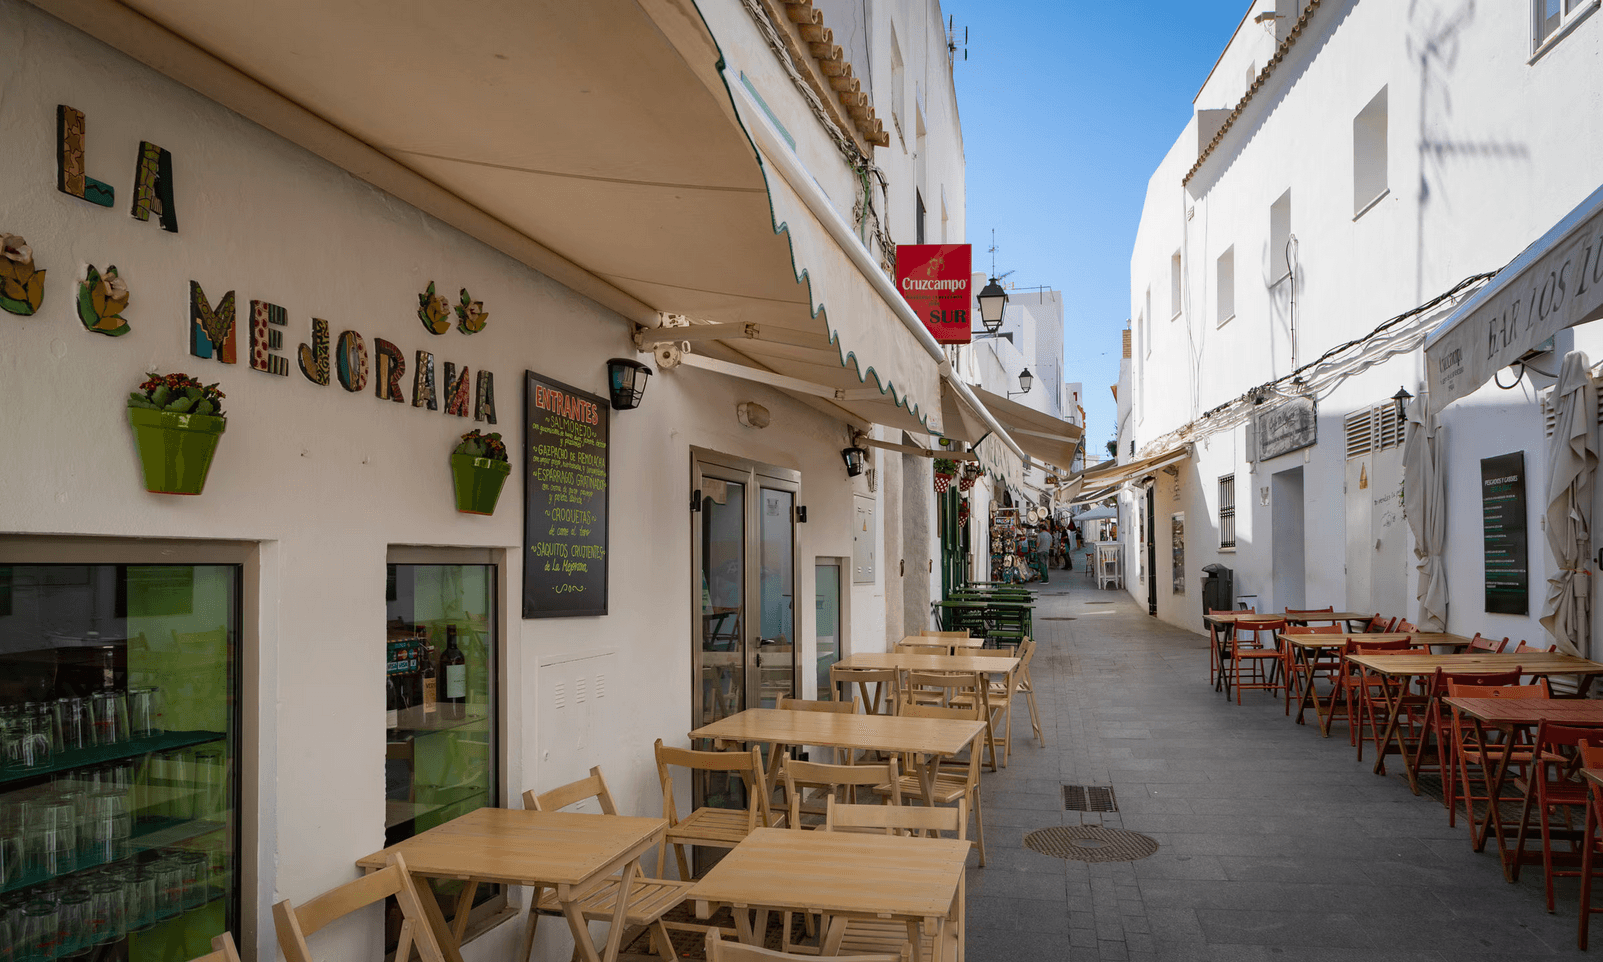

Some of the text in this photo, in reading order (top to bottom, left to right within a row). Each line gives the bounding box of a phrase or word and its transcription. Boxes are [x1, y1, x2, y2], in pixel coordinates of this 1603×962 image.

[56, 104, 178, 233] LA
[902, 277, 967, 293] Cruzcampo
[929, 309, 967, 324] SUR
[189, 280, 498, 425] MEJORANA
[535, 385, 599, 426] ENTRANTES
[550, 415, 592, 438] SALMOREJO
[538, 444, 569, 460] GAZPACHO
[551, 507, 591, 525] CROQUETAS
[548, 524, 555, 537] de
[536, 541, 604, 561] SAQUITOS CRUJIENTES
[544, 557, 589, 577] de La Mejorana
